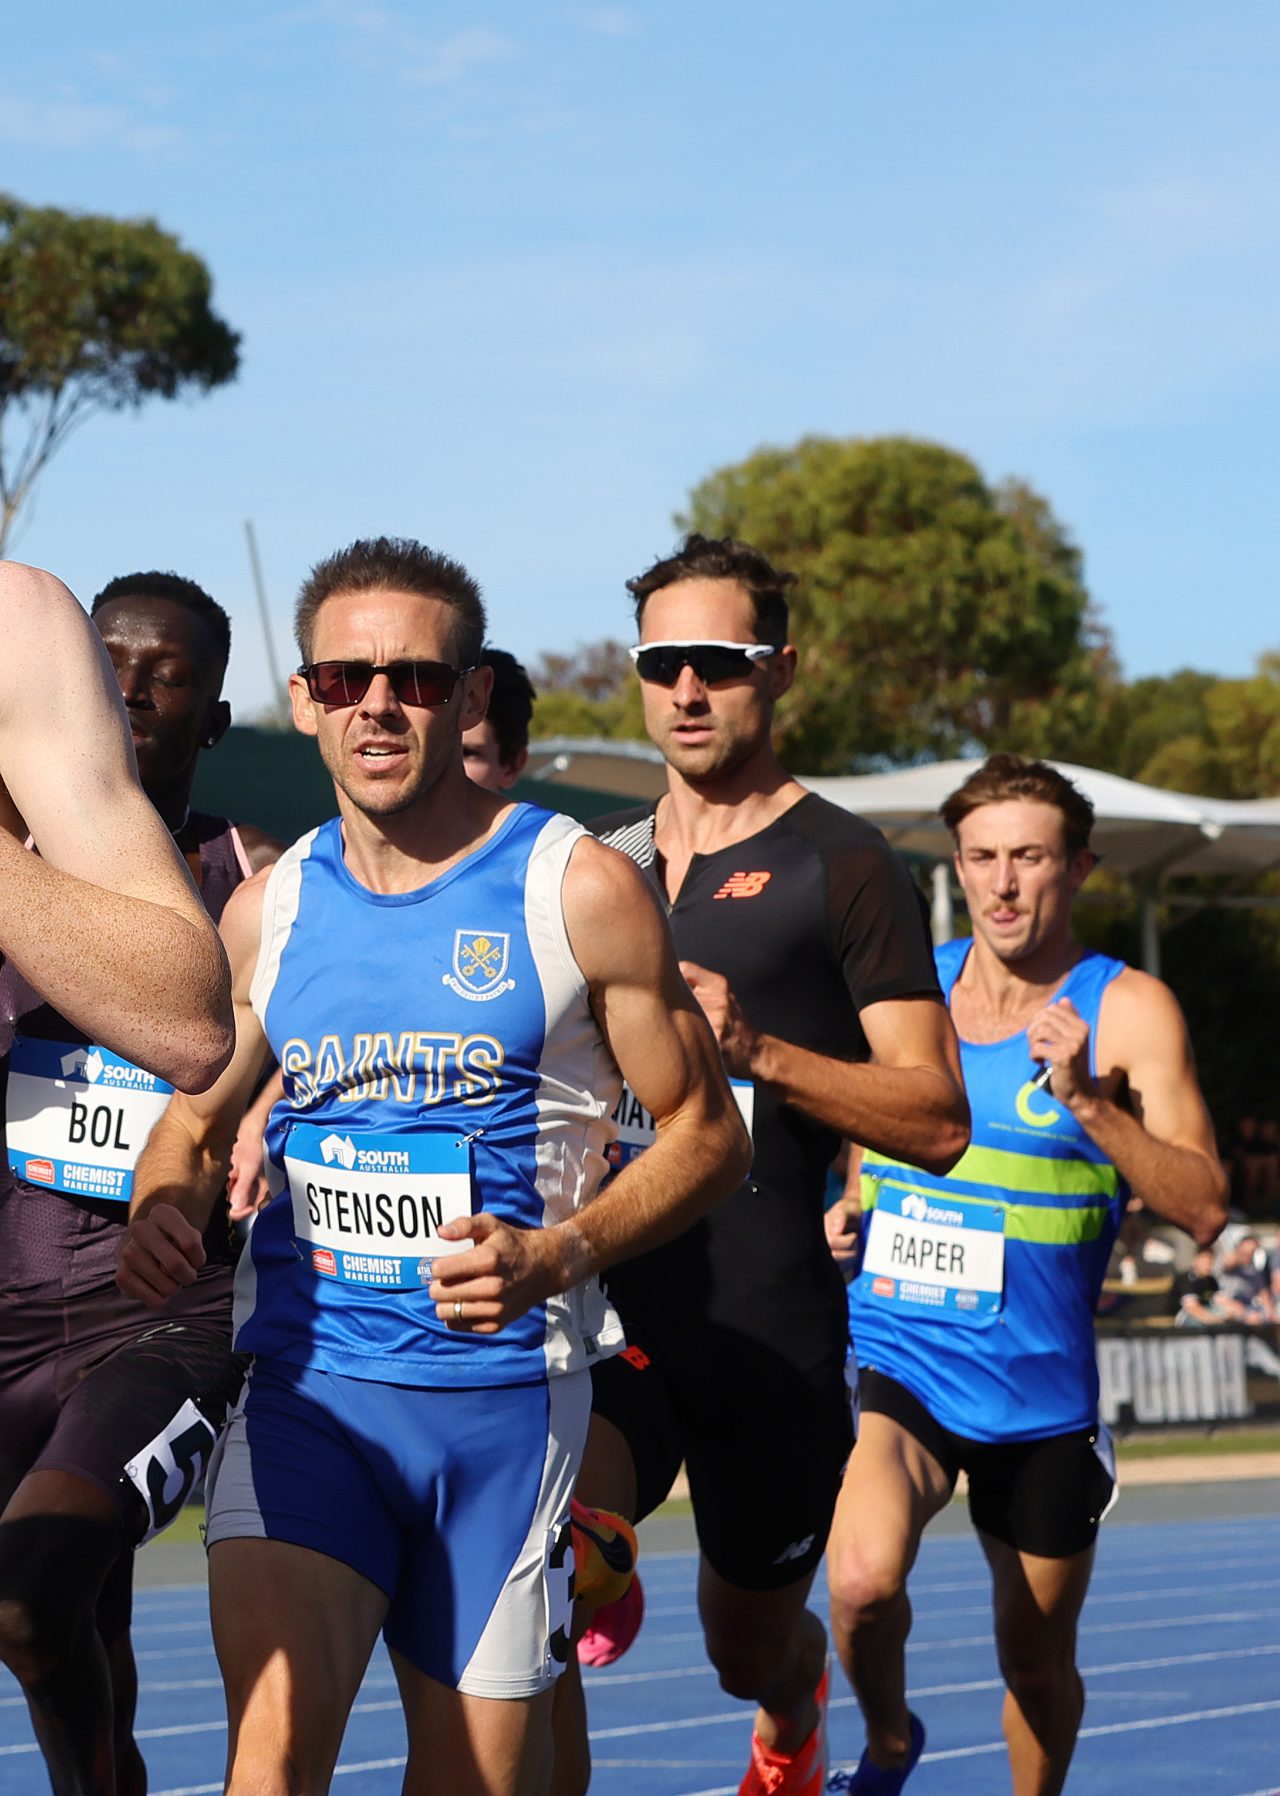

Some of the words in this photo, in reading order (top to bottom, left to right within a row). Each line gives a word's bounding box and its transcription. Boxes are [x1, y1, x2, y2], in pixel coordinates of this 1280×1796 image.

[103, 1064, 156, 1085] SOUTH
[282, 1032, 506, 1109] SAINTS
[103, 1078, 154, 1091] AUSTRALIA
[69, 1101, 130, 1150] BOL
[357, 1149, 410, 1167] SOUTH
[359, 1163, 410, 1174] AUSTRALIA
[63, 1163, 125, 1187] CHEMIST
[63, 1179, 122, 1196] WAREHOUSE
[306, 1182, 444, 1239] STENSON
[342, 1254, 402, 1275] CHEMIST
[891, 1232, 965, 1275] RAPER
[344, 1270, 402, 1284] WAREHOUSE
[1097, 1334, 1249, 1423] PUMA
[146, 1419, 216, 1529] 5
